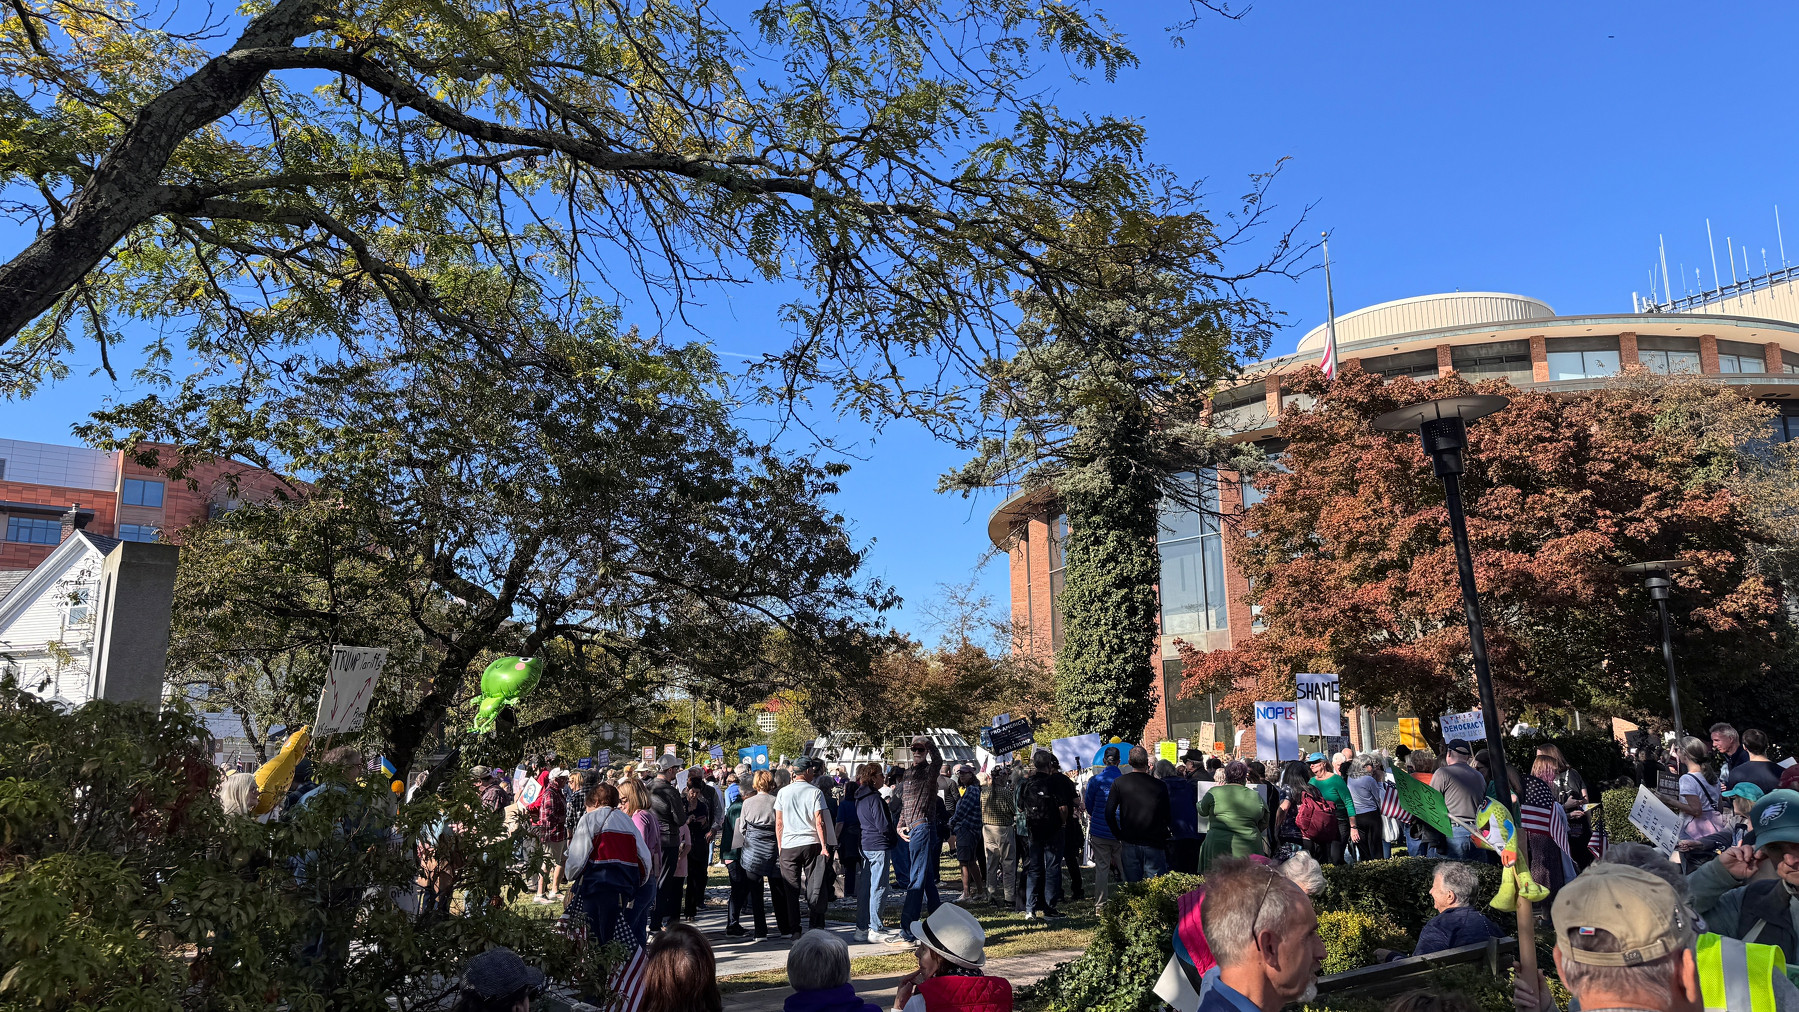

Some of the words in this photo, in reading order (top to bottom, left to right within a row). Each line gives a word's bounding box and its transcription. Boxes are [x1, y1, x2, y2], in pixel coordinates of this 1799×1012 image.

[335, 650, 360, 672] TRUMP
[1296, 681, 1339, 702] SHAME
[1256, 706, 1295, 720] NOPE
[1443, 720, 1484, 733] DEMOCRACY
[1412, 790, 1427, 812] NO
[1421, 784, 1443, 828] KINGS!
[1642, 806, 1654, 830] RACIST
[1649, 815, 1659, 836] UGLY
[1655, 825, 1665, 842] MEAN
